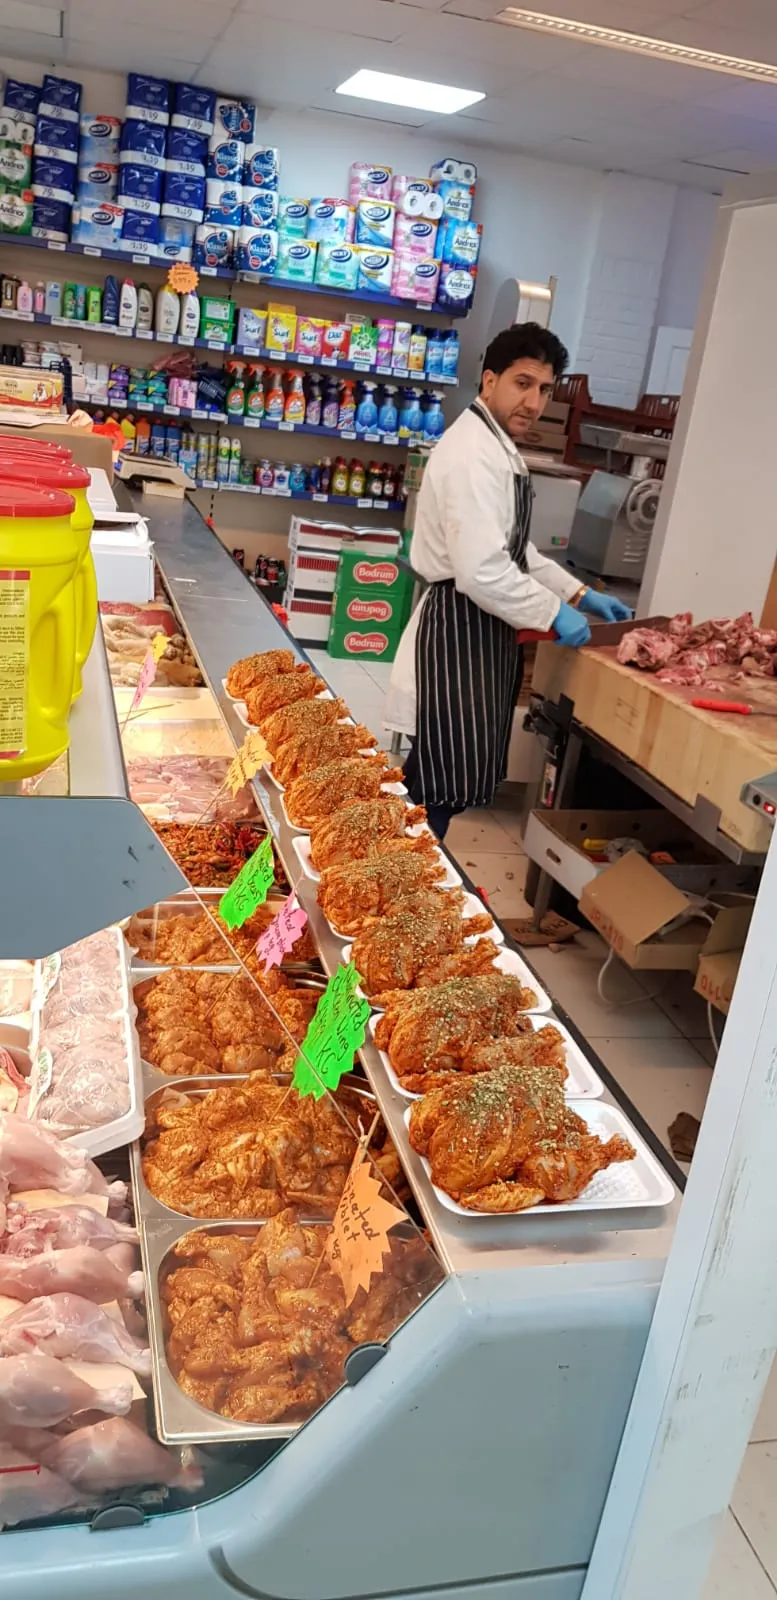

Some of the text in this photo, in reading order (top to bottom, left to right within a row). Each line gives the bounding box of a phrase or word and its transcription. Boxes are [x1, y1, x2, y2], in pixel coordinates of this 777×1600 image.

[446, 198, 469, 209] Andrex
[454, 238, 477, 249] Andrex
[244, 325, 261, 334] Surf
[273, 327, 290, 338] Surf
[301, 332, 318, 342] Surf
[359, 567, 395, 580] Bodrum
[351, 604, 387, 616] Bodrum
[349, 637, 385, 650] Bodrum
[337, 1014, 349, 1062] Wing
[339, 1191, 361, 1242] iblet
